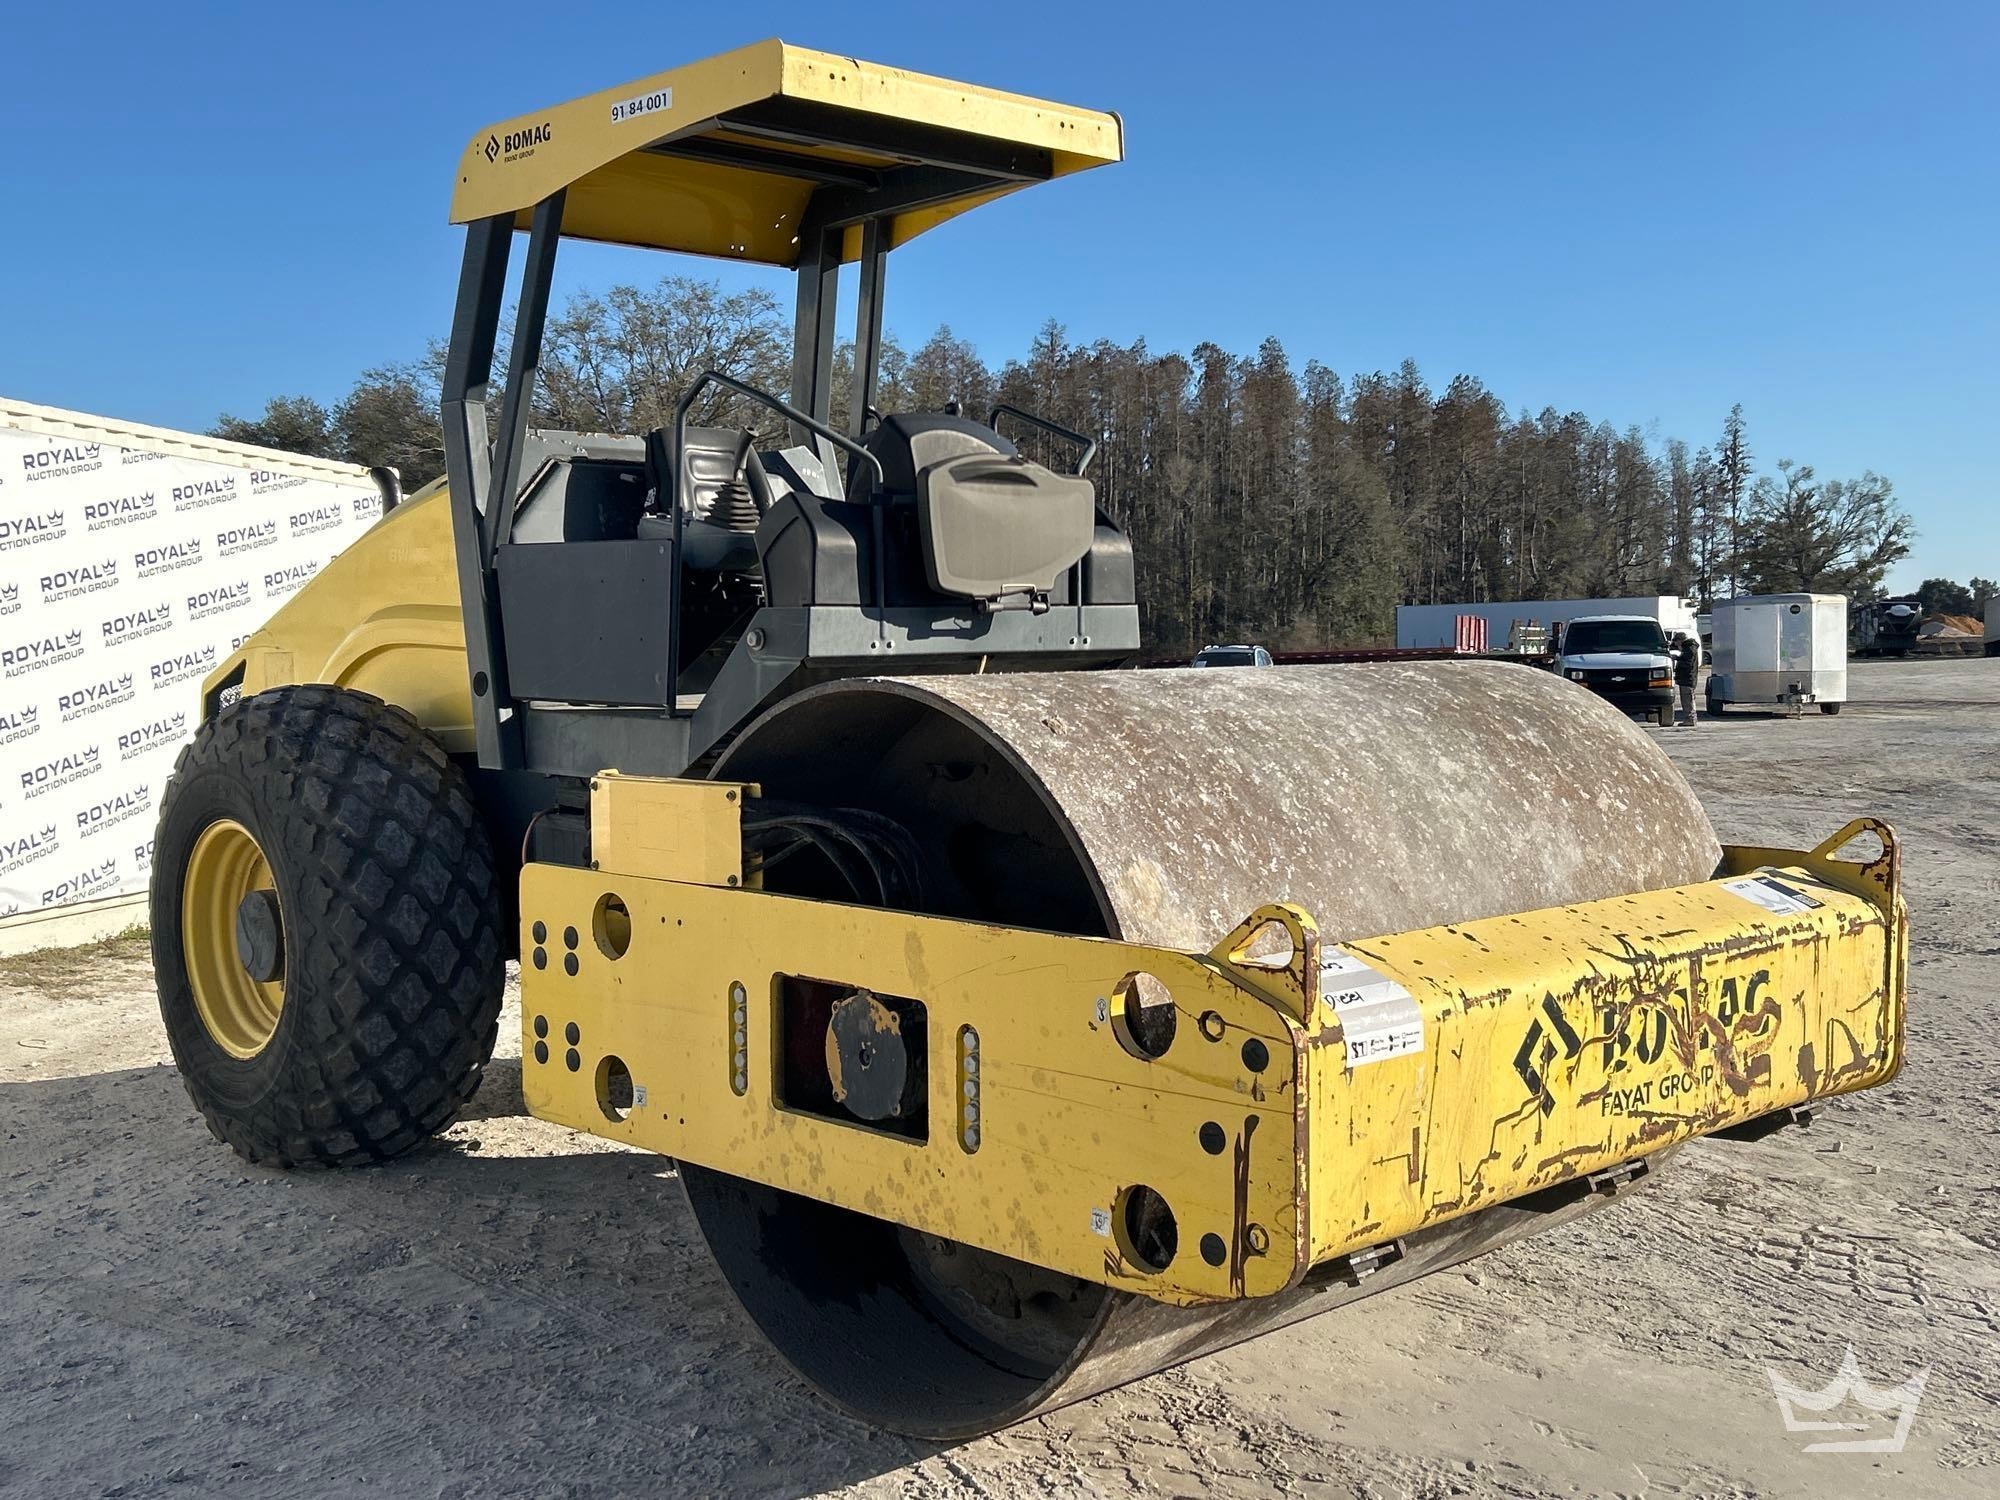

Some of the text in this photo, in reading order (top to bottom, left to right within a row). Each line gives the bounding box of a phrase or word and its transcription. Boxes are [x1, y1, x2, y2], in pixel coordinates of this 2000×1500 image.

[612, 93, 667, 121] 91 84 001
[505, 123, 551, 153] BOMAG
[23, 446, 85, 469] ROYAL
[26, 462, 102, 482] AUCTION GROUP
[250, 471, 288, 485] ROY
[172, 479, 223, 502] ROYAL
[175, 493, 237, 512] AUCTION GROUP
[85, 496, 141, 520] ROYAL
[290, 507, 331, 528] ROYAL
[0, 515, 48, 538] OYAL
[88, 510, 157, 532] AUCTION GROUP
[292, 519, 342, 538] AUCTION GROUP
[0, 530, 67, 551] CTION GROUP
[217, 524, 264, 547] ROYAL
[219, 536, 278, 557] AUCTION GROUP
[135, 543, 188, 568] ROYAL
[138, 556, 202, 579] AUCTION GROUP
[40, 565, 103, 592] ROYAL
[264, 565, 307, 588] ROYAL
[43, 578, 119, 604] AUCTION GROUP
[187, 586, 237, 611] ROYAL
[266, 583, 297, 598] AUCTION
[1, 603, 21, 615] OUP
[190, 597, 251, 621] AUCTION GROUP
[102, 609, 156, 636] ROYAL
[105, 621, 173, 648] AUCTION GROUP
[2, 636, 65, 667] ROYAL
[5, 648, 84, 679] AUCTION GROUP
[151, 652, 202, 680] ROYAL
[153, 662, 217, 690] AUCTION GROUP
[58, 681, 119, 711] ROYAL
[62, 691, 135, 723] AUCTION GROUP
[6, 724, 40, 744] GROUP
[118, 719, 172, 750] ROYAL
[121, 729, 187, 761] AUCTION GROUP
[21, 753, 84, 788] ROYAL
[25, 763, 102, 800] AUCTION GROUP
[76, 793, 135, 828] ROYAL
[80, 802, 151, 839] AUCTION GROUP
[0, 842, 59, 877] TION GROUP
[42, 868, 102, 906] ROYAL
[88, 875, 120, 896] GROUP
[1602, 1081, 1653, 1117] FAYAT
